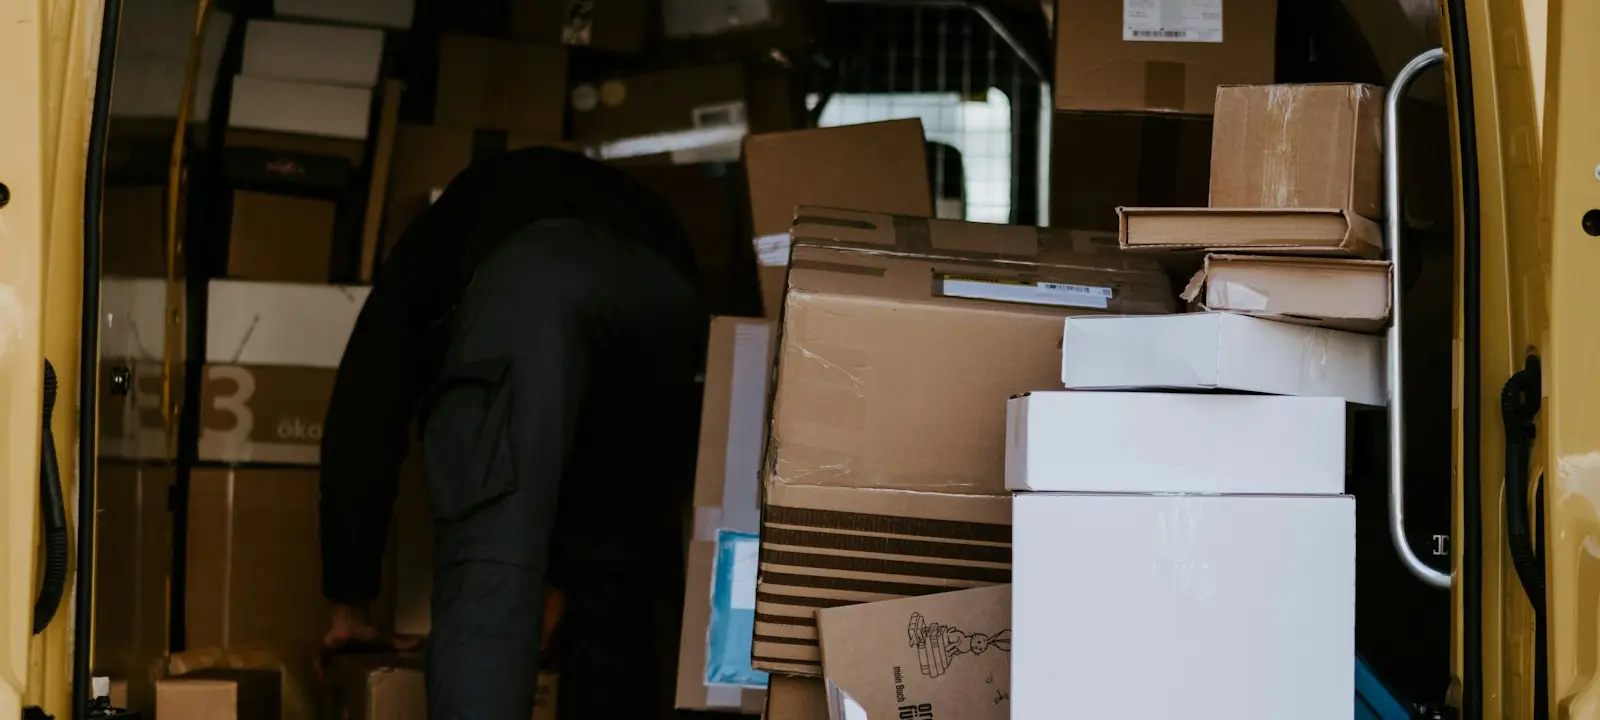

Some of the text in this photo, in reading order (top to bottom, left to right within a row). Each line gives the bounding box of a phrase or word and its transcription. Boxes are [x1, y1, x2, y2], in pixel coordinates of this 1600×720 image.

[894, 667, 917, 720] mein Buch fü
[918, 703, 933, 720] or
